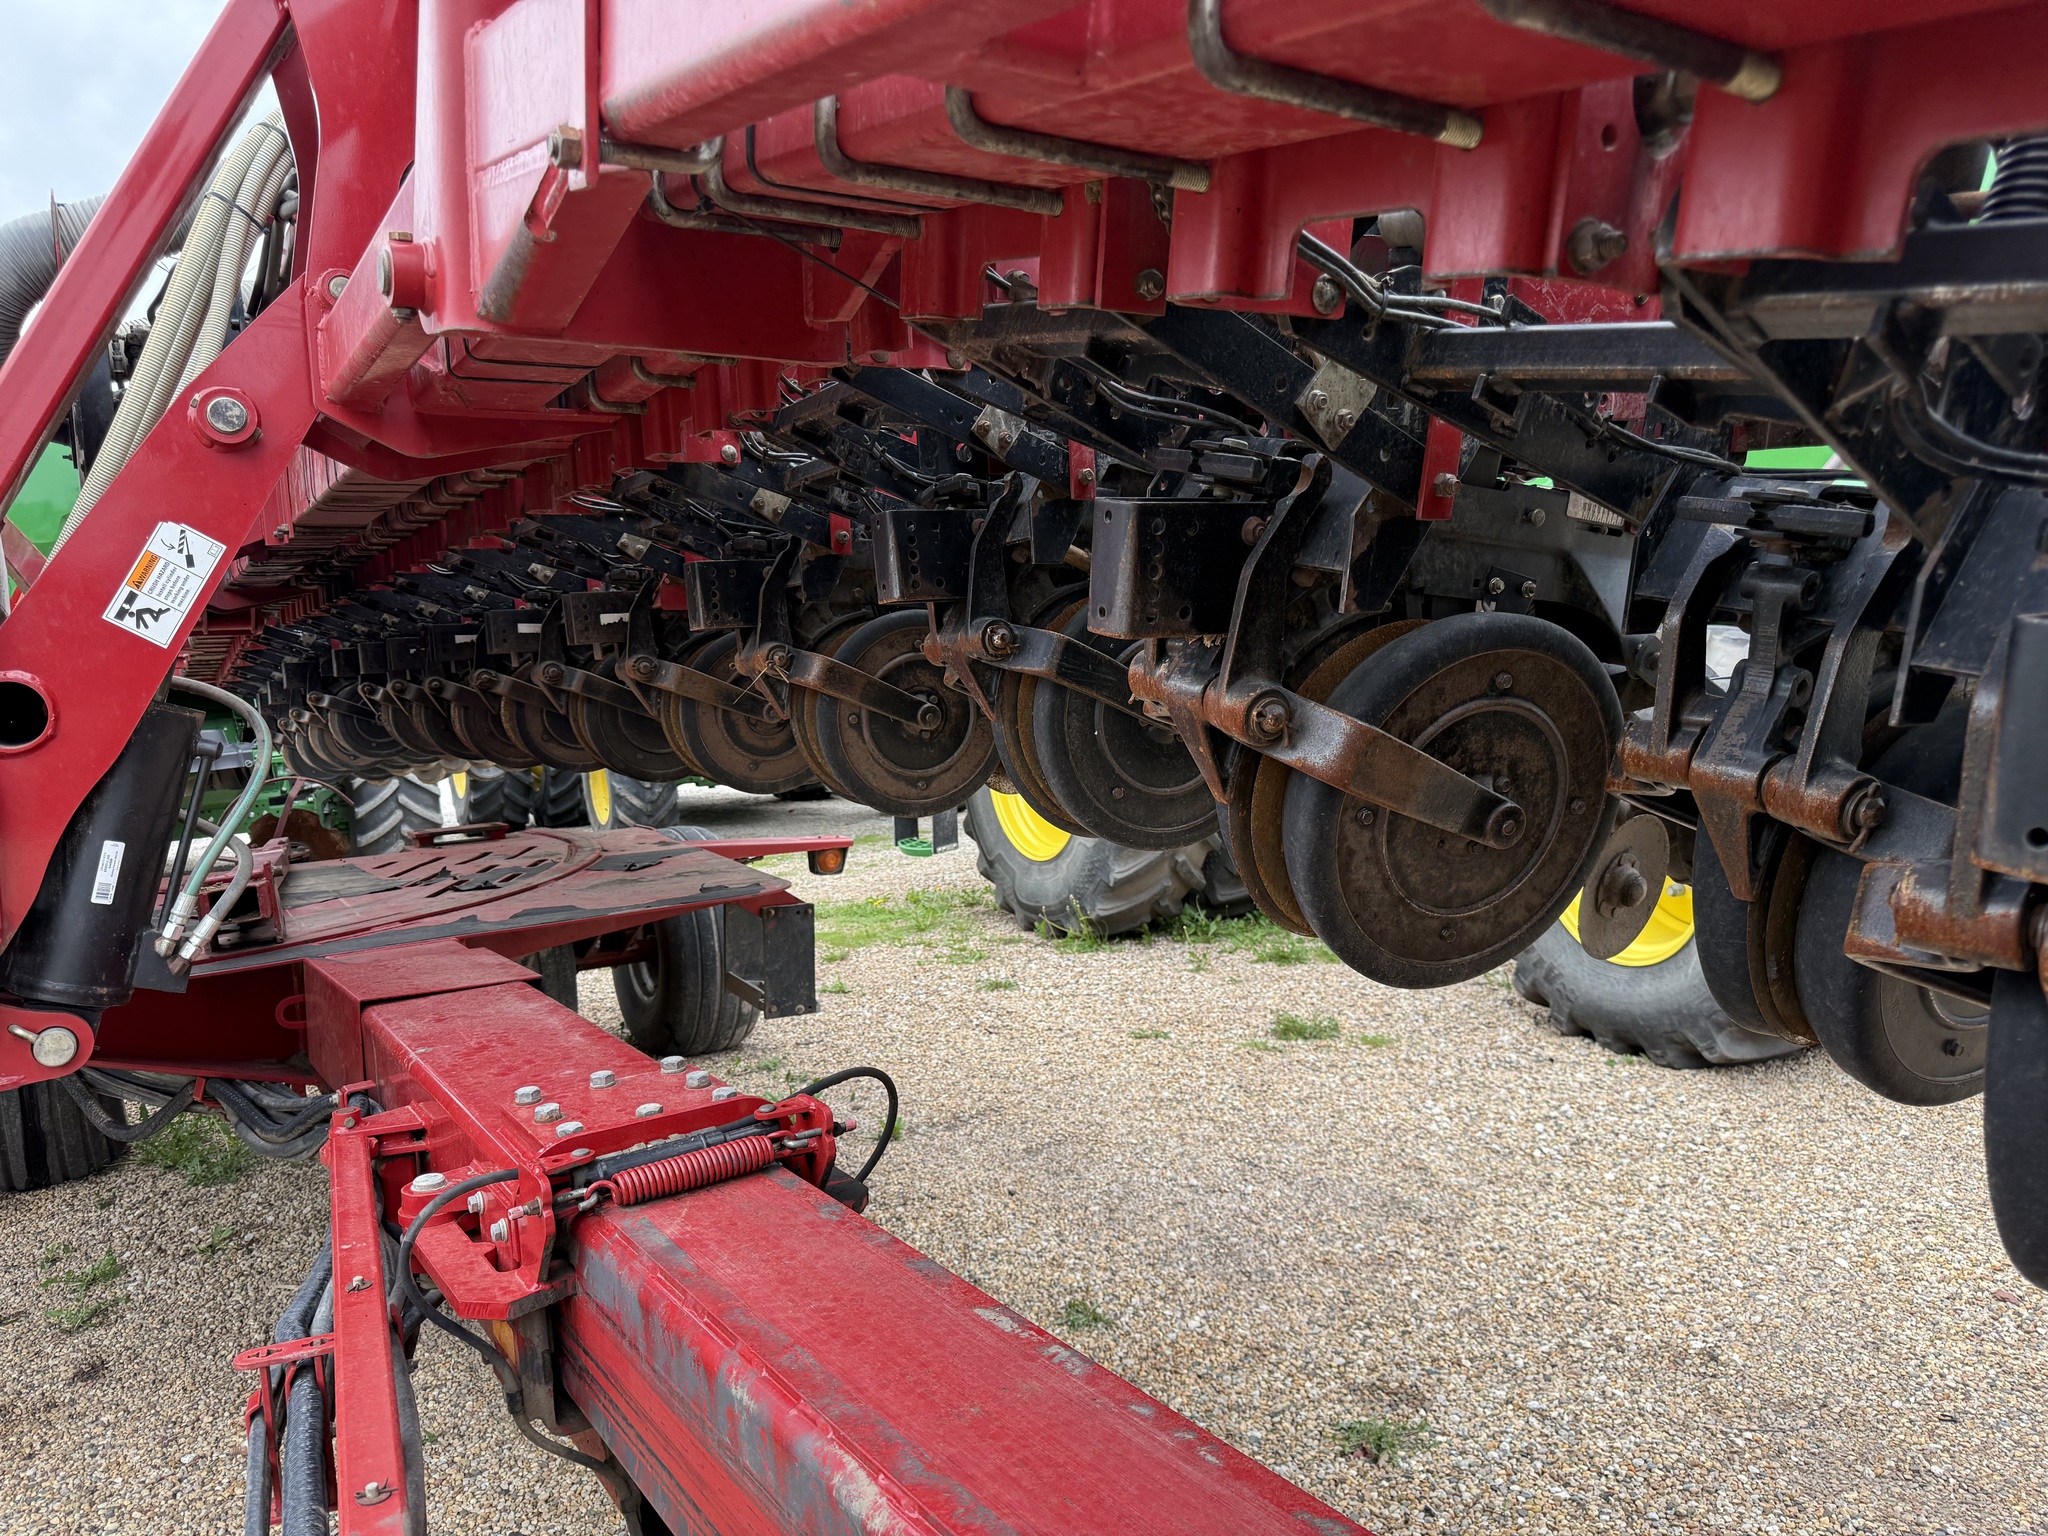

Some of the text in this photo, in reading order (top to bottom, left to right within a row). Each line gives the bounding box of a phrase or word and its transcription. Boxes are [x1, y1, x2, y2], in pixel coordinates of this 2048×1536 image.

[138, 555, 158, 581] WARNING
[148, 562, 170, 594] CRUSH HAZARD
[166, 567, 177, 584] cylinder
